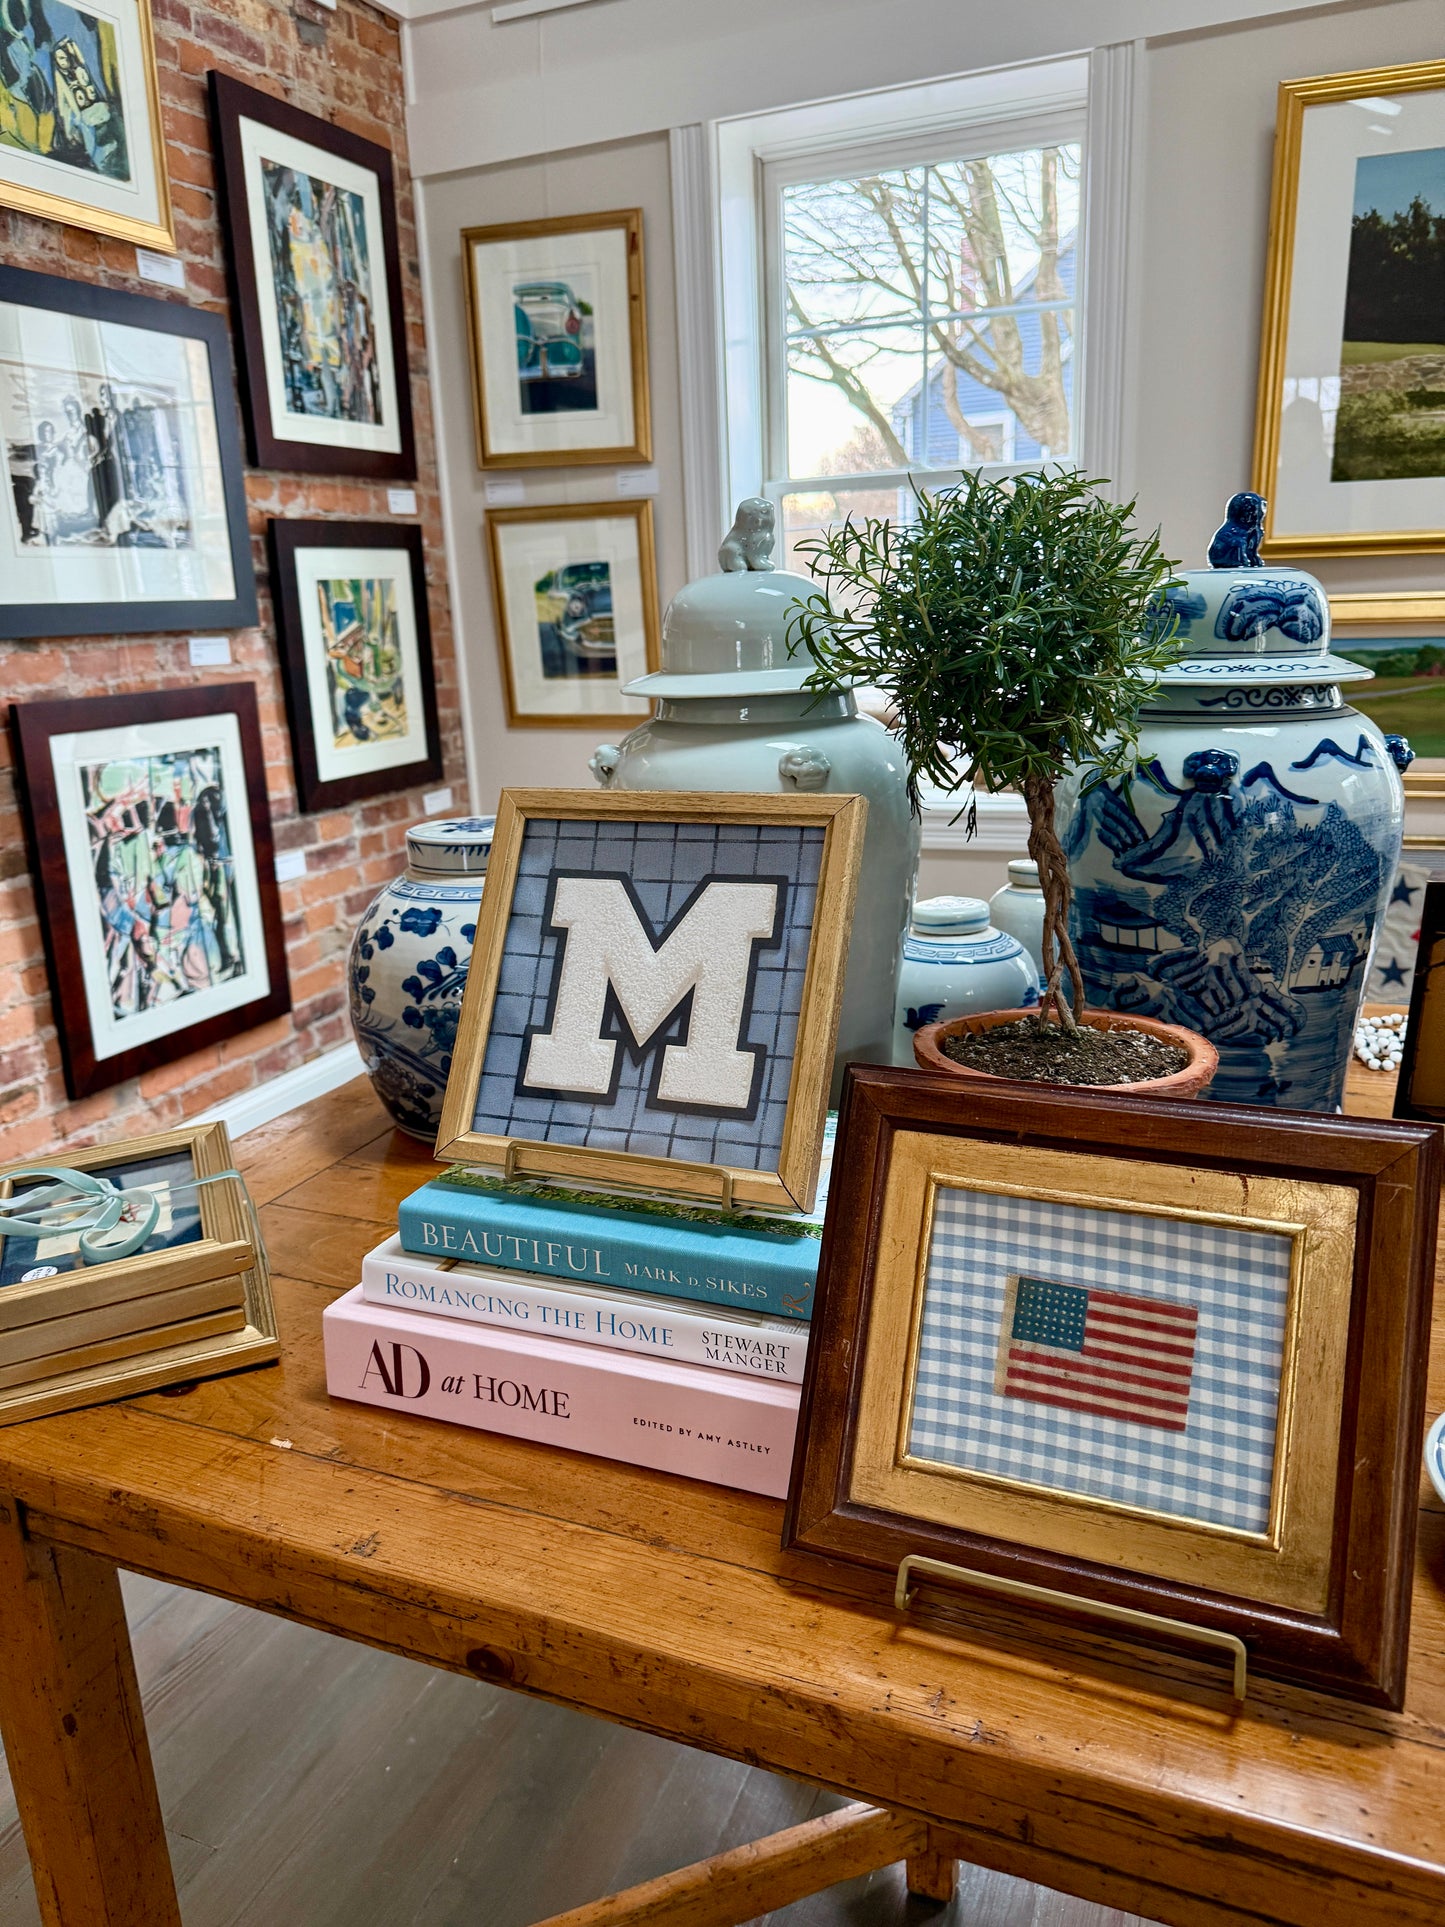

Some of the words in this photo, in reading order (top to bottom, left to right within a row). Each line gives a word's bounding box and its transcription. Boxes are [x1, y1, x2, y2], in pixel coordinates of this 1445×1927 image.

[515, 868, 789, 1121] M
[420, 1221, 611, 1277] BEAUTIFUL
[624, 1262, 681, 1284] MARK
[706, 1276, 768, 1299] SIKES
[385, 1273, 529, 1320] ROMANCING
[537, 1305, 586, 1330] THE
[595, 1310, 674, 1347] HOME
[701, 1330, 790, 1360] STEWART
[706, 1346, 788, 1375] MANGER
[358, 1338, 431, 1399] AD
[441, 1374, 466, 1395] at
[472, 1373, 571, 1419] HOME
[633, 1417, 673, 1433] EDITED
[679, 1427, 692, 1437] BY
[697, 1432, 721, 1443] AMY
[727, 1439, 771, 1455] ASTLEY
